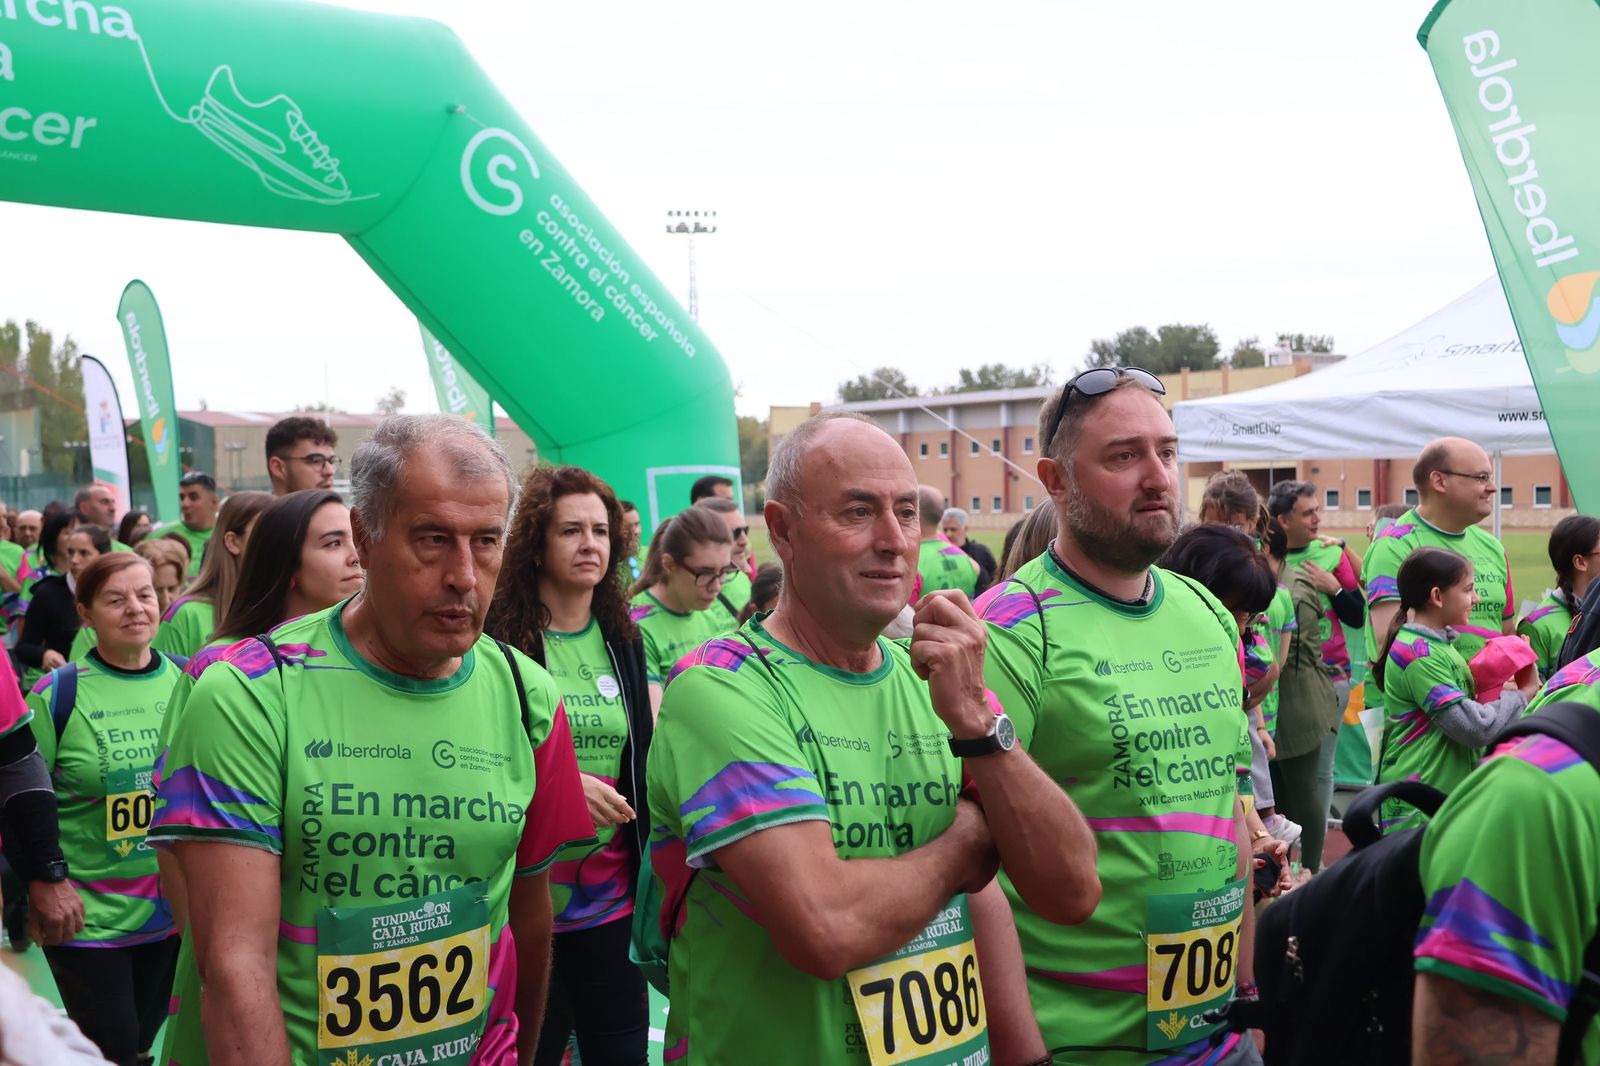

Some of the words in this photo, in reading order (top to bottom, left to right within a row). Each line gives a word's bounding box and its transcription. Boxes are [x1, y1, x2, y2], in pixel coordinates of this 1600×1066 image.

[519, 228, 545, 256] en
[540, 250, 606, 322] Zamora
[536, 210, 590, 269] contra
[588, 266, 608, 287] el
[604, 284, 659, 343] cáncer
[549, 194, 630, 285] asociación
[630, 283, 697, 358] española
[1232, 422, 1281, 436] SmartChip
[1112, 659, 1154, 674] Iberdrola
[1122, 693, 1156, 720] En
[1156, 683, 1240, 717] marcha
[108, 728, 135, 743] En
[337, 743, 411, 759] Iberdrola
[816, 731, 871, 752] Iberdrola
[1103, 694, 1131, 789] ZAMORA
[1134, 722, 1211, 753] contra
[1136, 757, 1162, 787] el
[331, 783, 380, 816] En
[393, 792, 525, 824] marcha
[825, 771, 864, 806] En
[1139, 795, 1159, 806] XVII
[1160, 793, 1192, 804] Carrera
[1193, 788, 1220, 799] Mucho
[111, 794, 155, 832] 60
[300, 782, 324, 893] ZAMORA
[327, 826, 455, 859] contra
[324, 864, 361, 897] el
[1175, 857, 1211, 872] ZAMORA
[372, 927, 405, 941] CAJA
[410, 914, 452, 934] RURAL
[925, 919, 964, 939] RURAL
[1192, 907, 1218, 919] CAJA
[373, 942, 384, 950] DE
[387, 935, 419, 948] ZAMORA
[908, 940, 937, 952] ZAMORA
[1155, 925, 1241, 1002] 708
[326, 945, 474, 1037] 3562
[859, 954, 979, 1055] 7086
